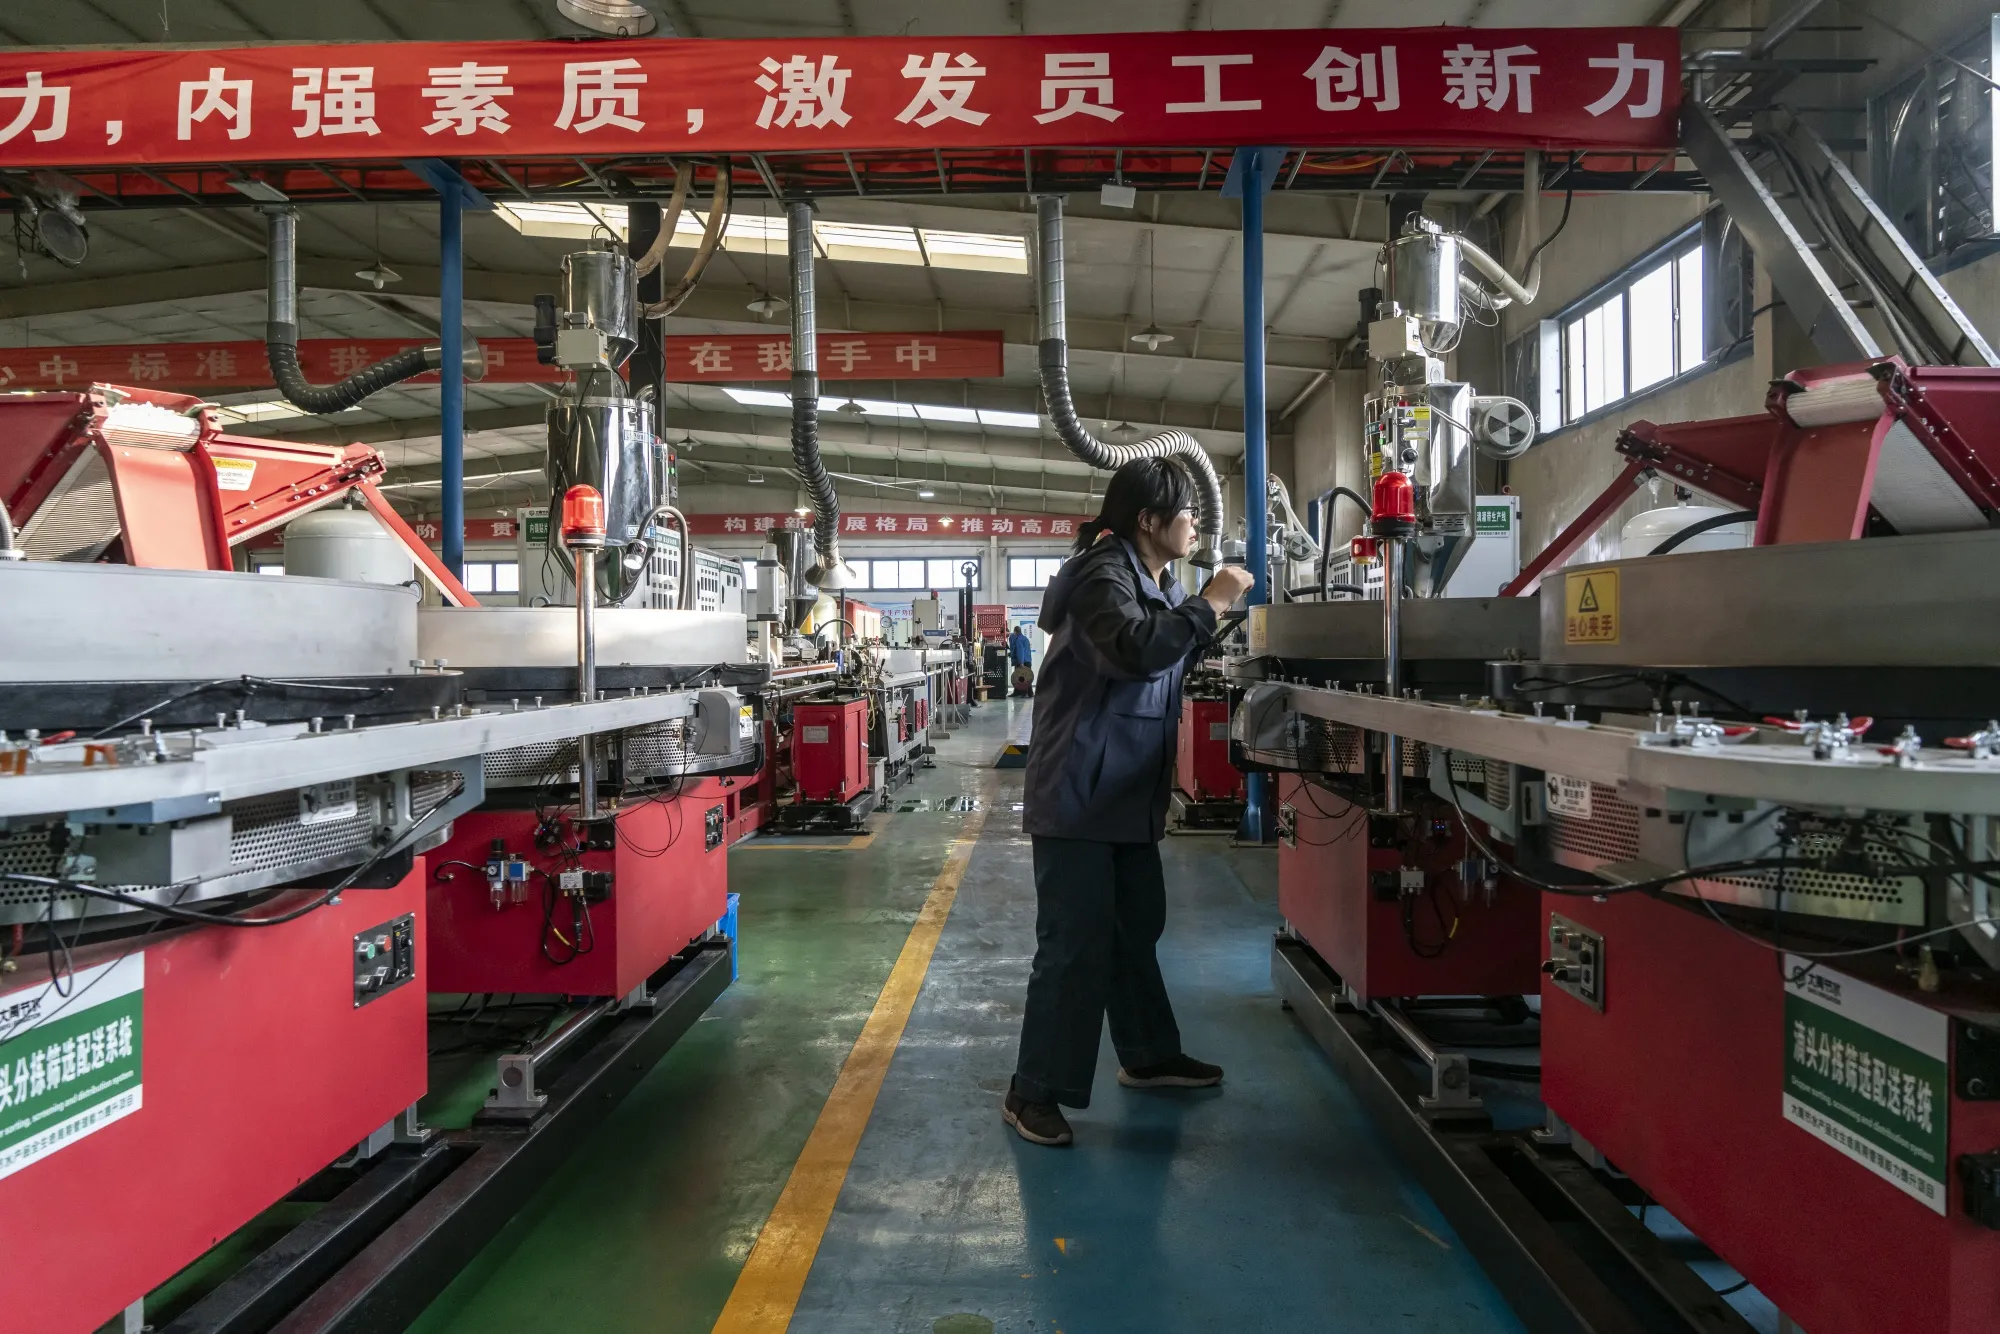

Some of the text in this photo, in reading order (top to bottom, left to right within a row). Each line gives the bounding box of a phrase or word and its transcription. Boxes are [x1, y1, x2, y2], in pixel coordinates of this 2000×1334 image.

[724, 516, 928, 532] 构建新展格局
